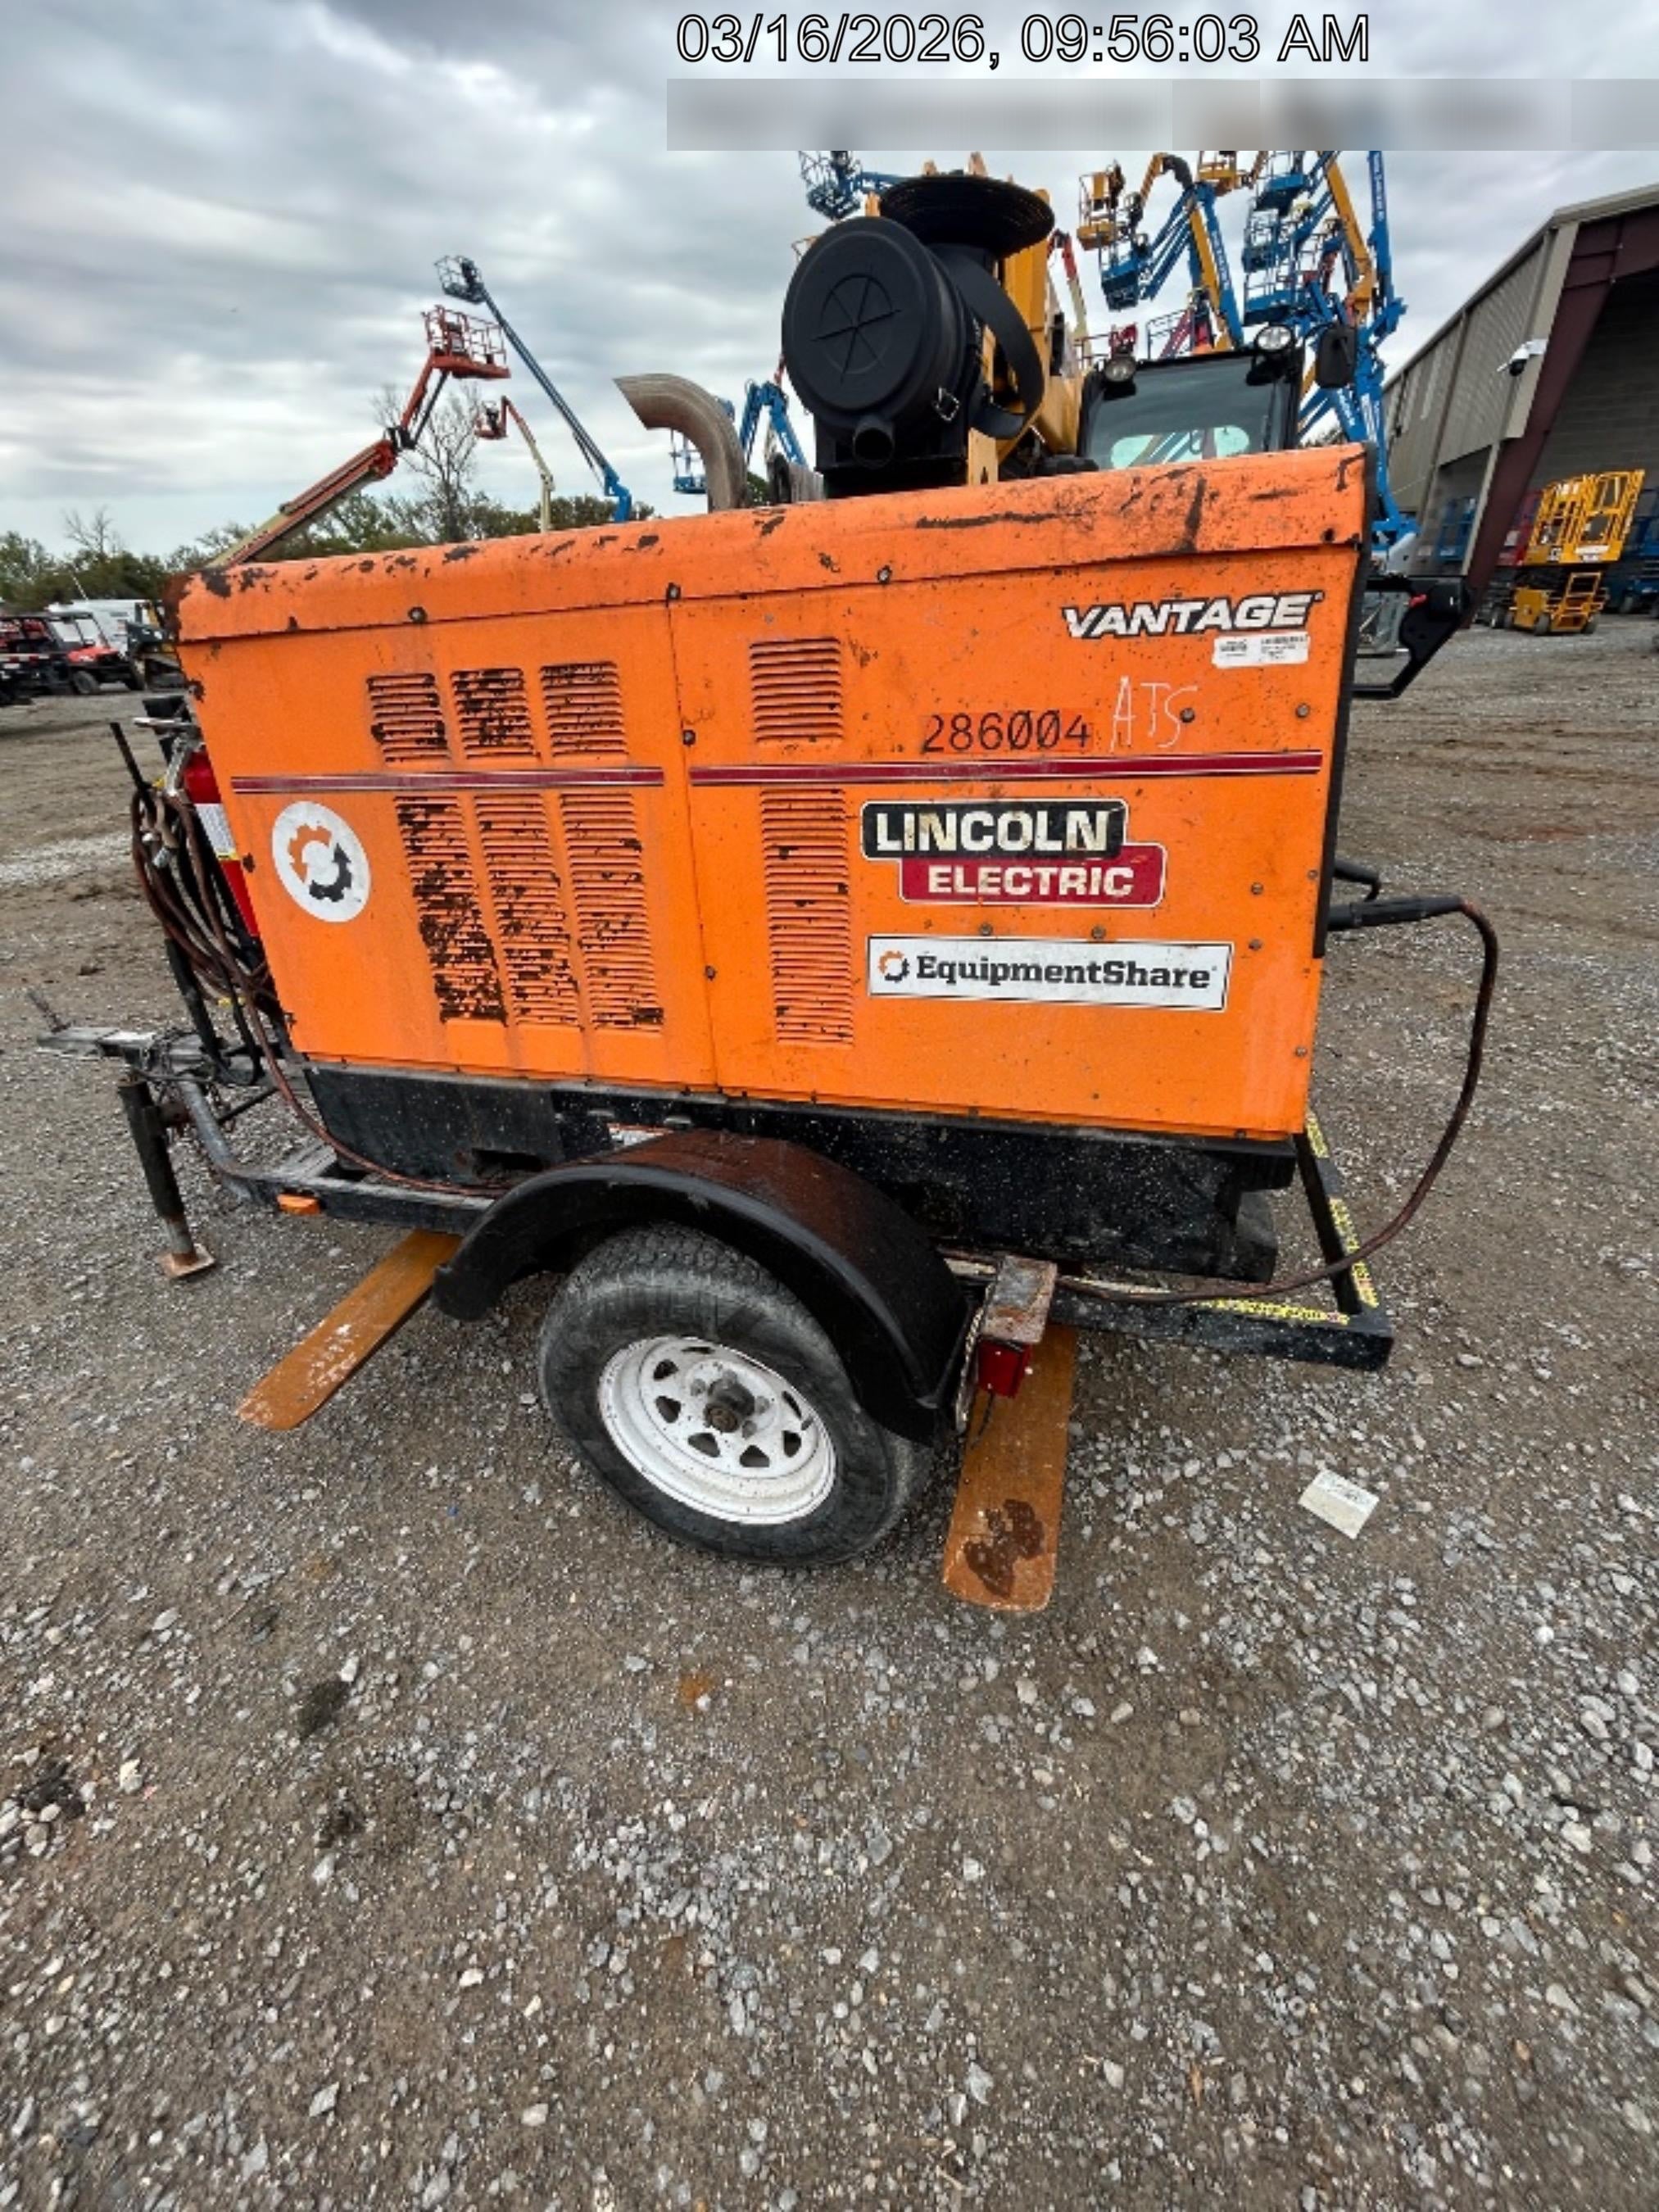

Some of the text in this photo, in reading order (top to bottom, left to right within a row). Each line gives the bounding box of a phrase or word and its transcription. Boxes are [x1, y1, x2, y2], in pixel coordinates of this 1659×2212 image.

[1063, 592, 1314, 638] VANTAGE
[922, 709, 1091, 754] 286004
[877, 810, 1109, 851] LINCOLN
[929, 865, 1135, 895] ELECTRIC
[916, 955, 1210, 989] EquipmentShare
